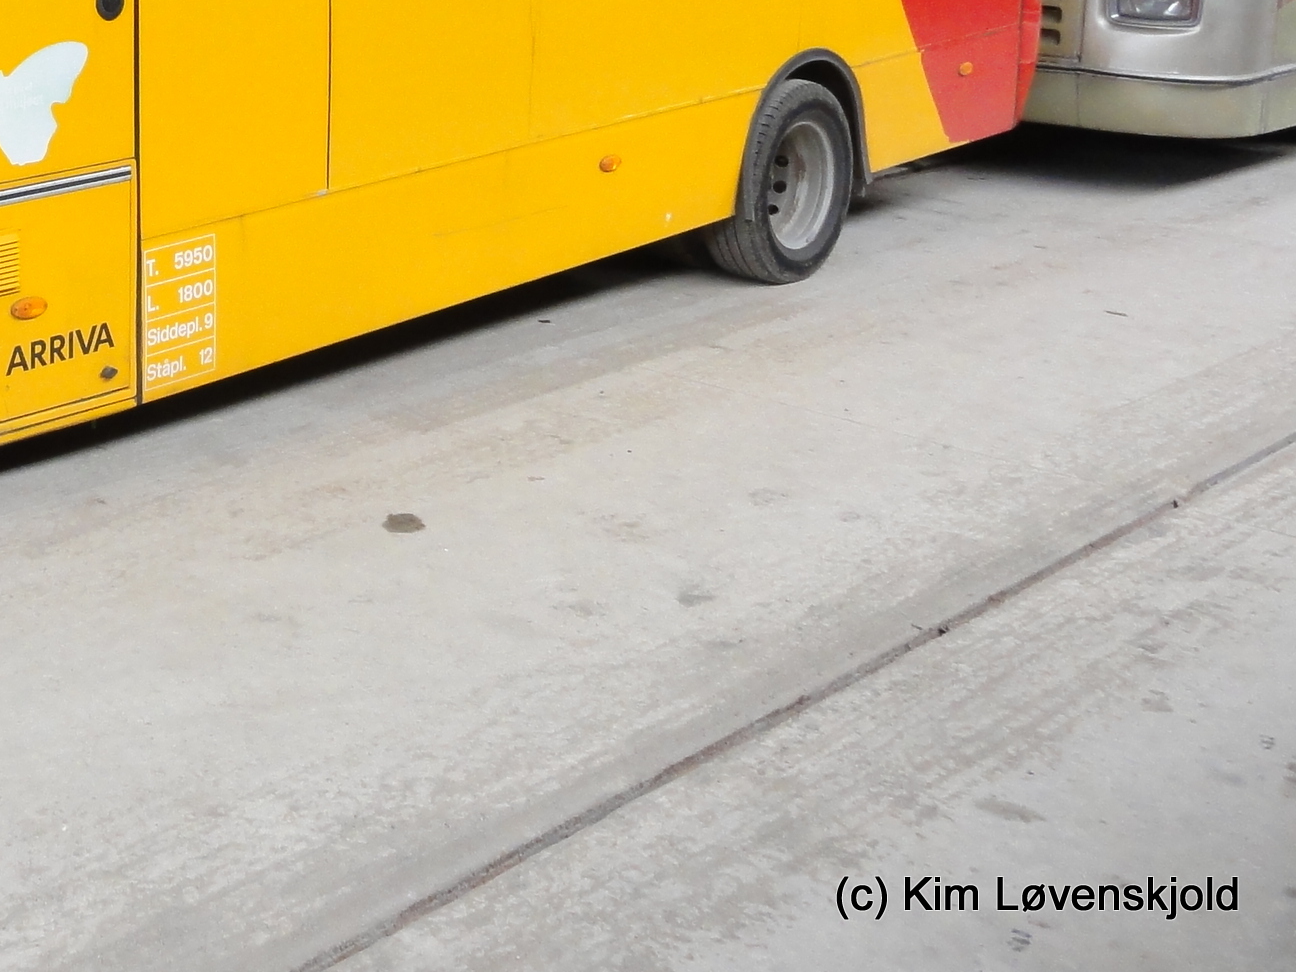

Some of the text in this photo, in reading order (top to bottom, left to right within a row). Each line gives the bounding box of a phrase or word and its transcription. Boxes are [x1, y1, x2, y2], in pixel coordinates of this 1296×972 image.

[146, 244, 213, 277] T. 5950
[147, 279, 214, 313] L. 1800
[147, 312, 214, 347] Siddepl. 9
[6, 321, 116, 377] ARRIVA
[146, 346, 213, 382] Ståpl. 12
